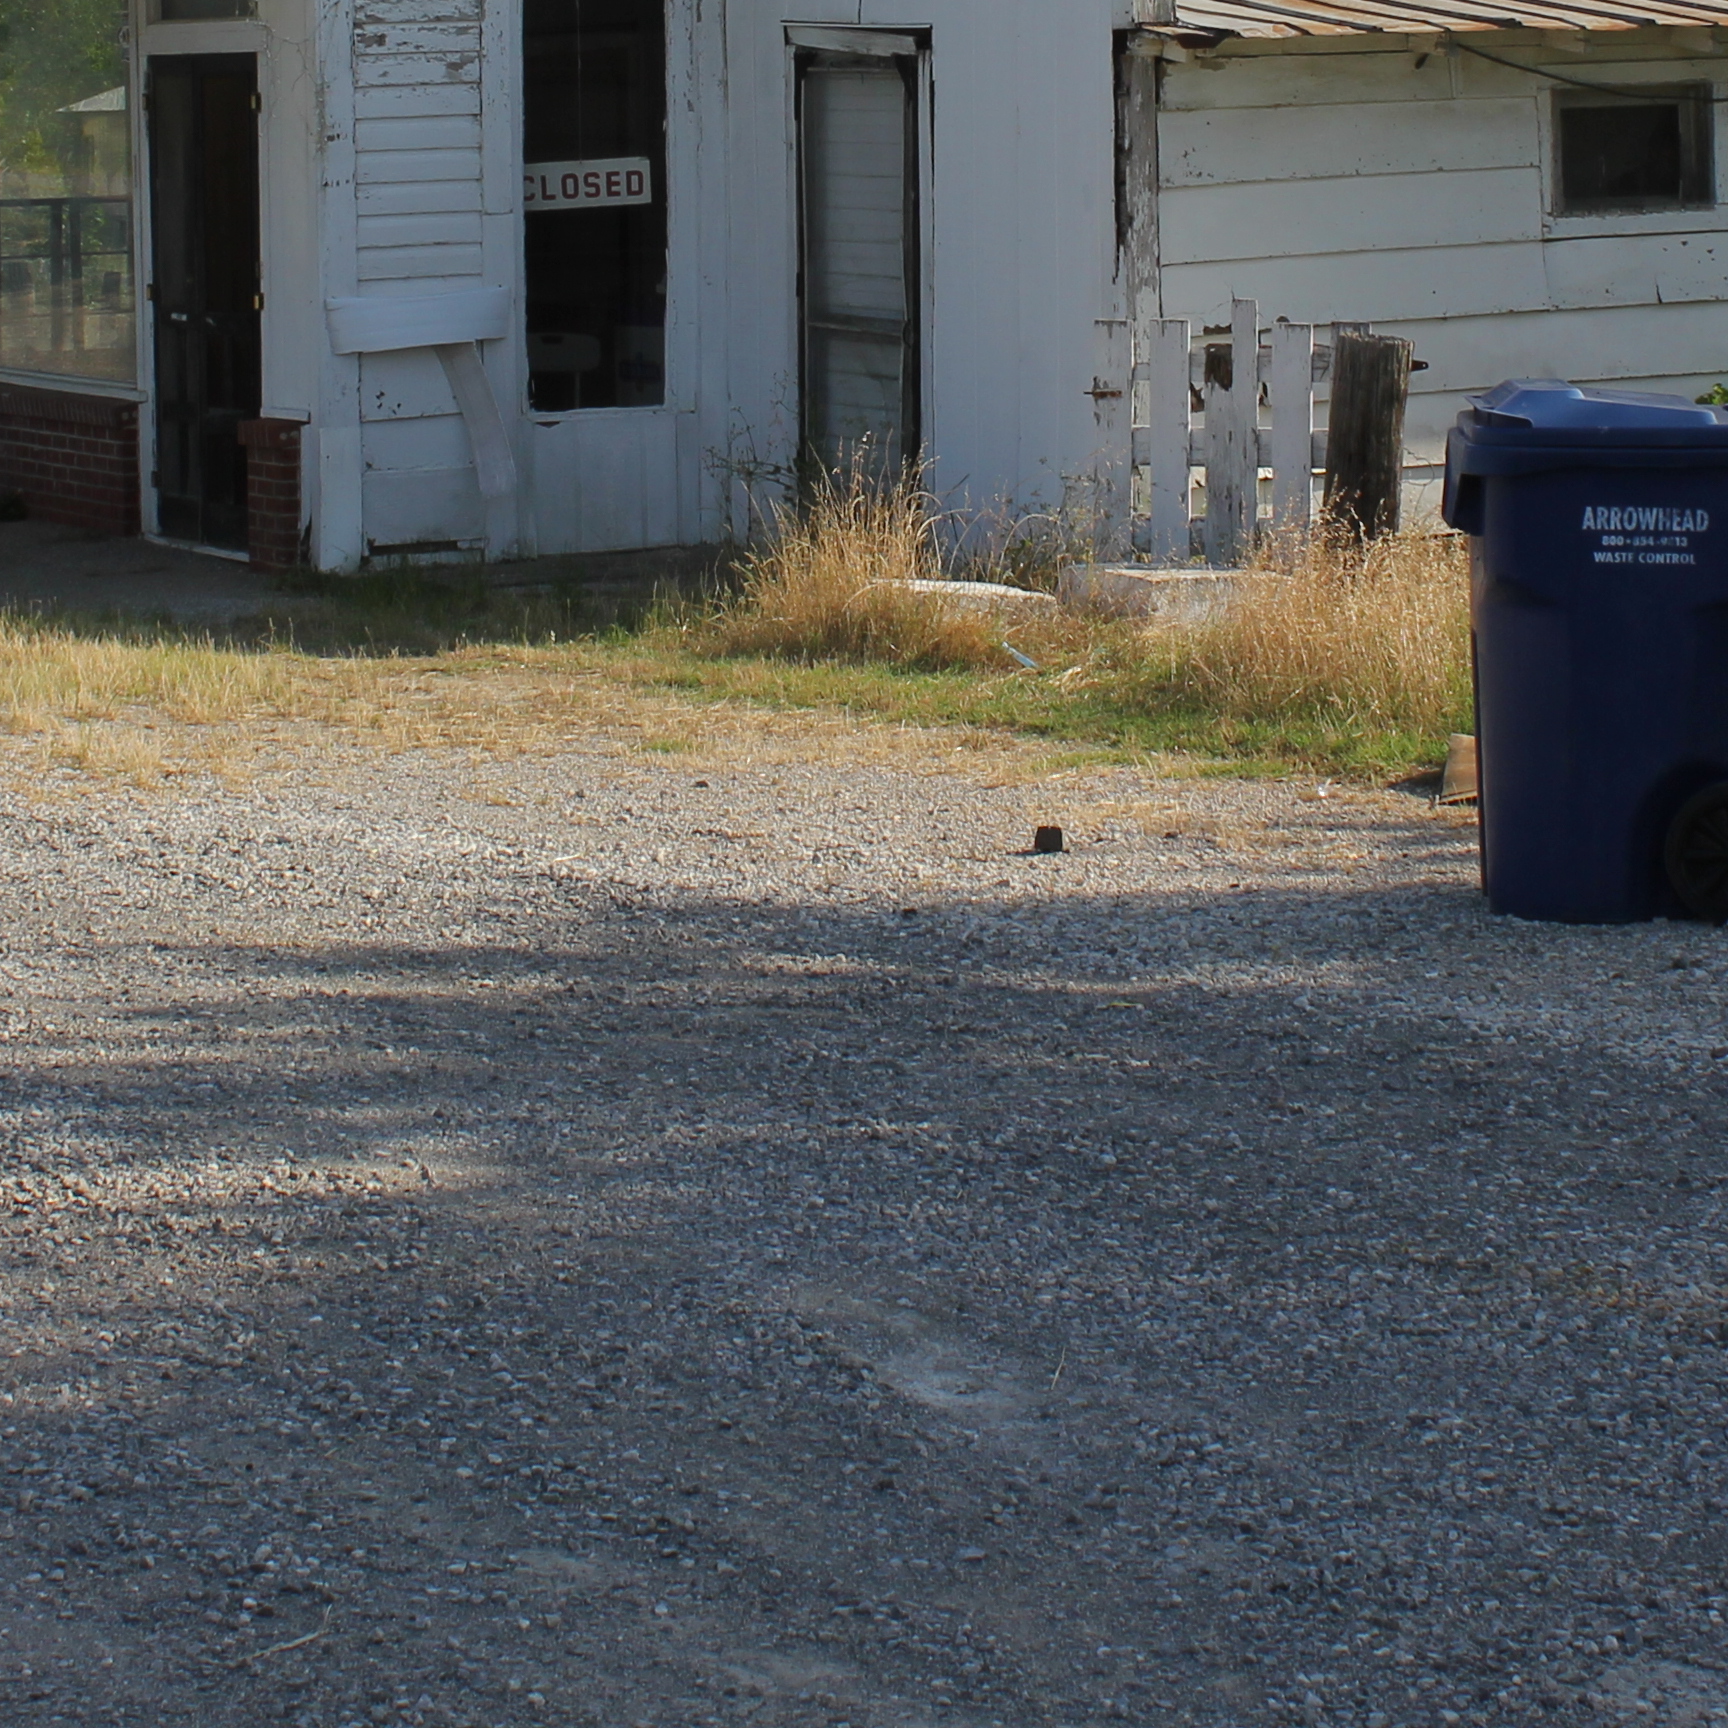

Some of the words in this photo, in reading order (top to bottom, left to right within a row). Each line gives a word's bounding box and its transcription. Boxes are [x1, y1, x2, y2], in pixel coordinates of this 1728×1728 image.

[523, 170, 644, 202] CLOSED
[1581, 505, 1710, 533] ARROWHEAD
[1593, 551, 1635, 564] WASTE
[1638, 552, 1697, 566] CONTROL
